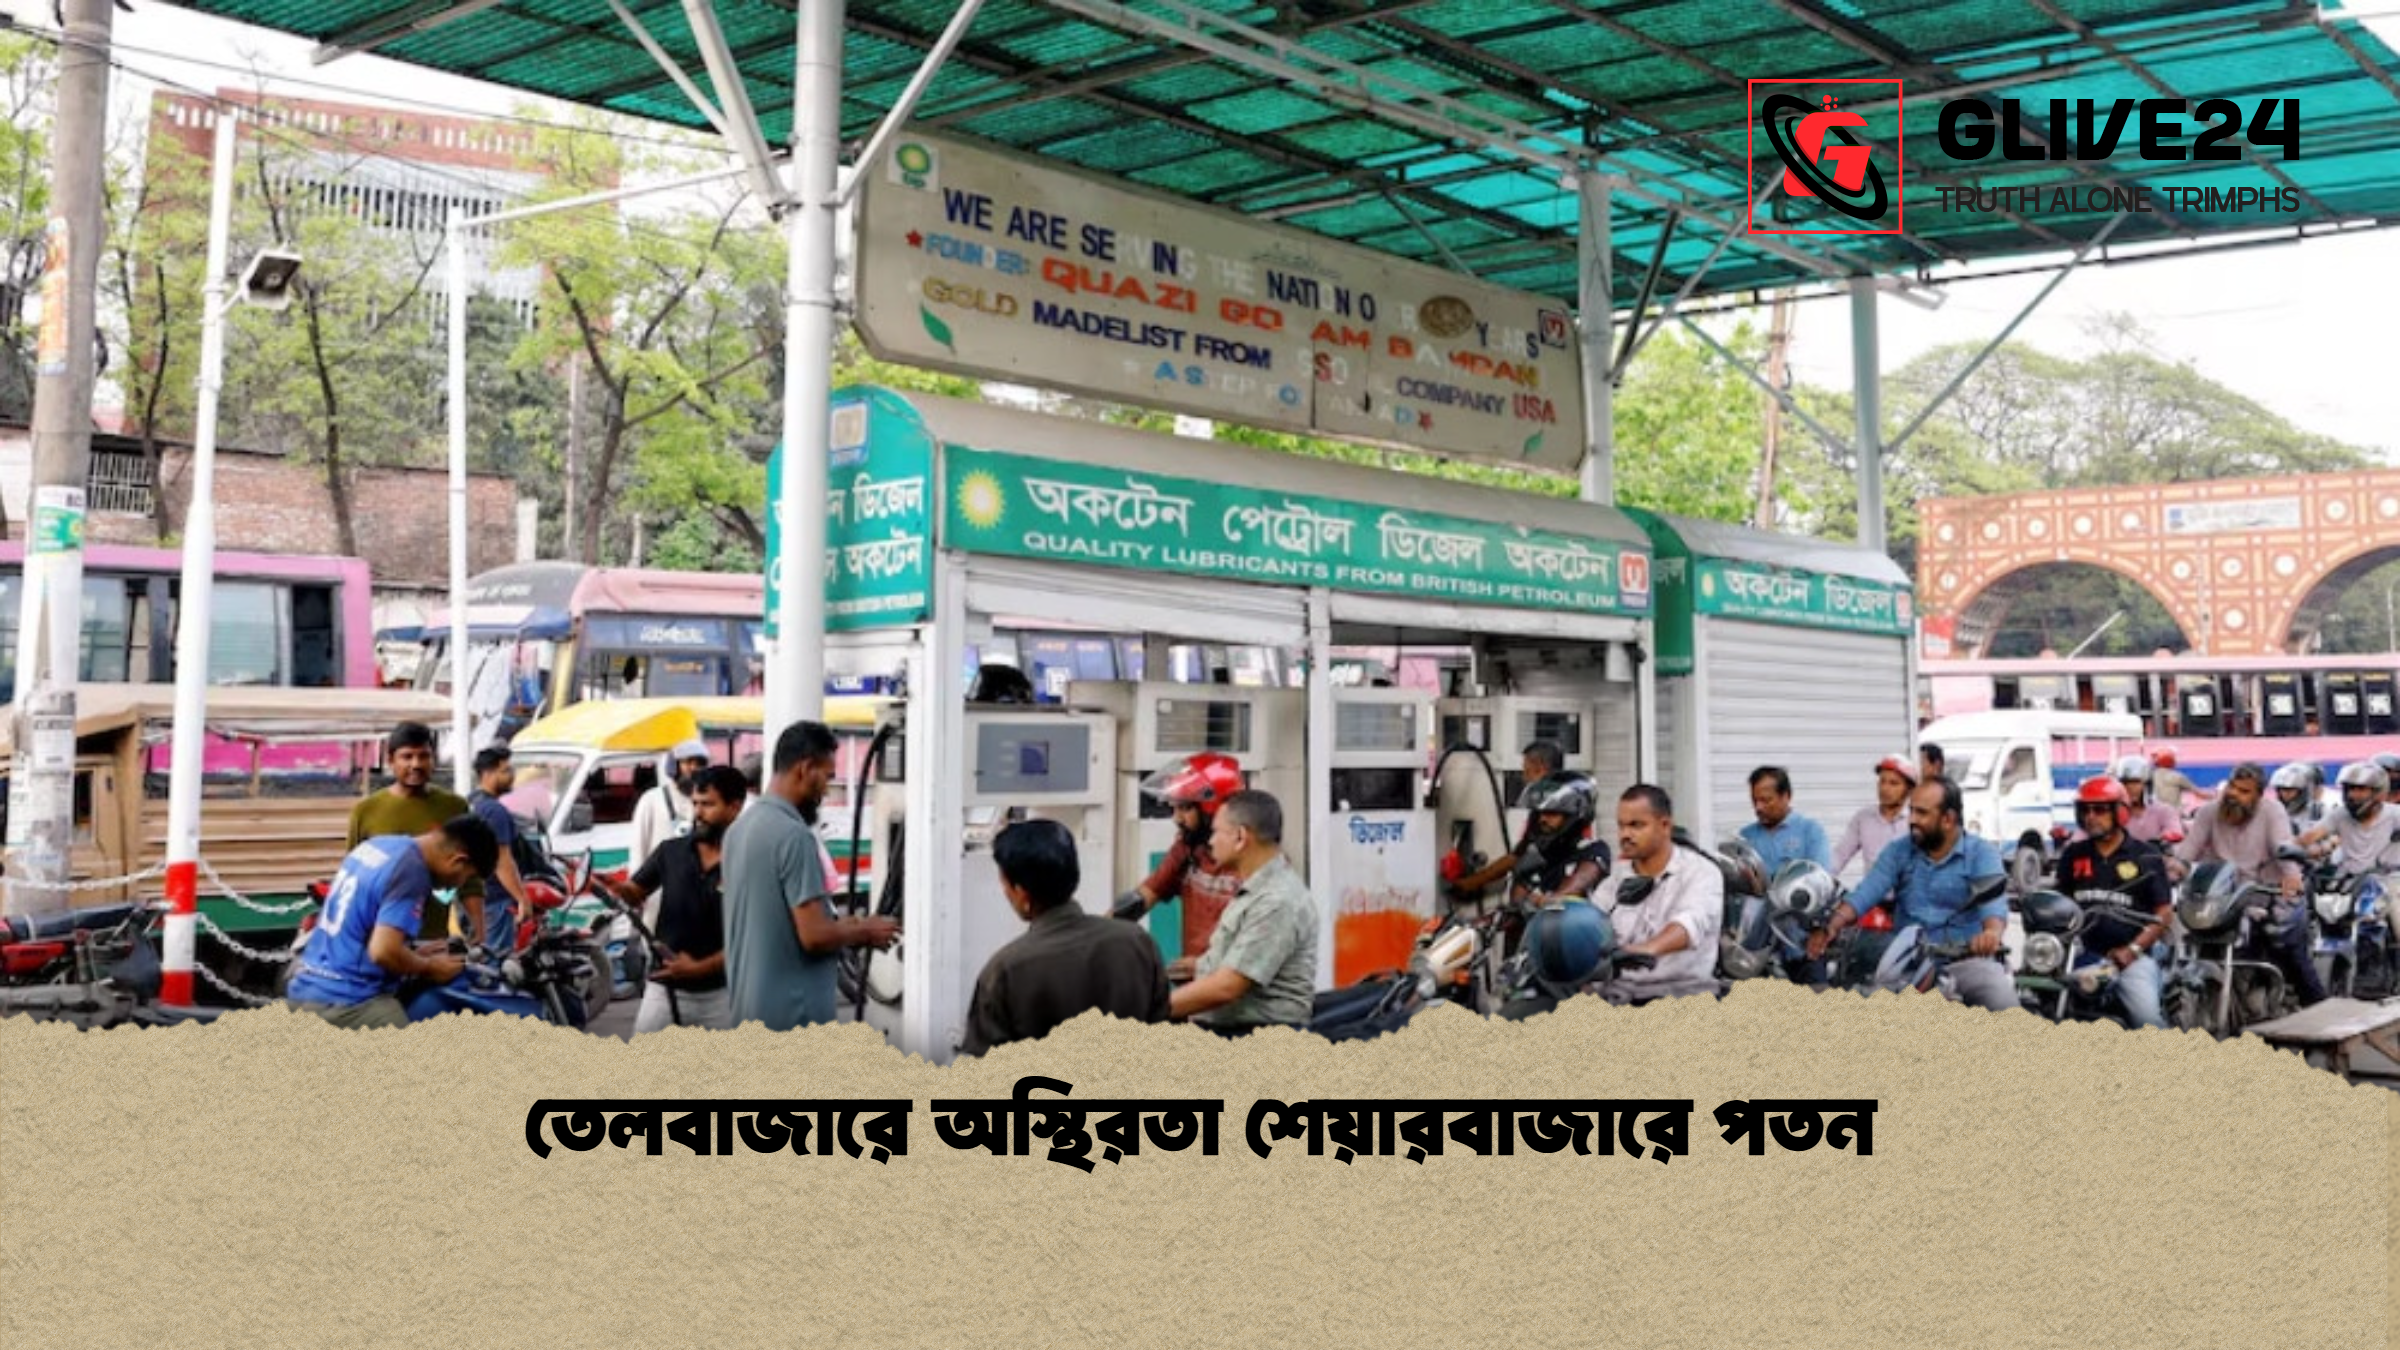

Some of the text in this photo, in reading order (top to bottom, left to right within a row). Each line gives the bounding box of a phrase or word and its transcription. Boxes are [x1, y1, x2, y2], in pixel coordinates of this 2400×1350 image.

[943, 188, 993, 232] WE
[1006, 206, 1067, 250] ARE
[1041, 256, 1198, 314] QUAZI
[923, 277, 1018, 318] GOLD
[1032, 301, 1187, 352] MADELIST
[1194, 334, 1272, 370] FROM
[1396, 376, 1505, 416] COMPANY
[1512, 393, 1558, 424] USA
[1022, 475, 1195, 536] অকটেন
[1223, 498, 1355, 556] পেট্রোল
[1376, 511, 1485, 571] ডিজেল
[1503, 539, 1611, 587] অকটেন
[1022, 531, 1153, 563] QUALITY
[1162, 545, 1330, 580] LUBRICANTS
[1335, 566, 1405, 588] FROM
[1411, 573, 1493, 596] BRITISH
[1498, 583, 1617, 609] PETROLEUM
